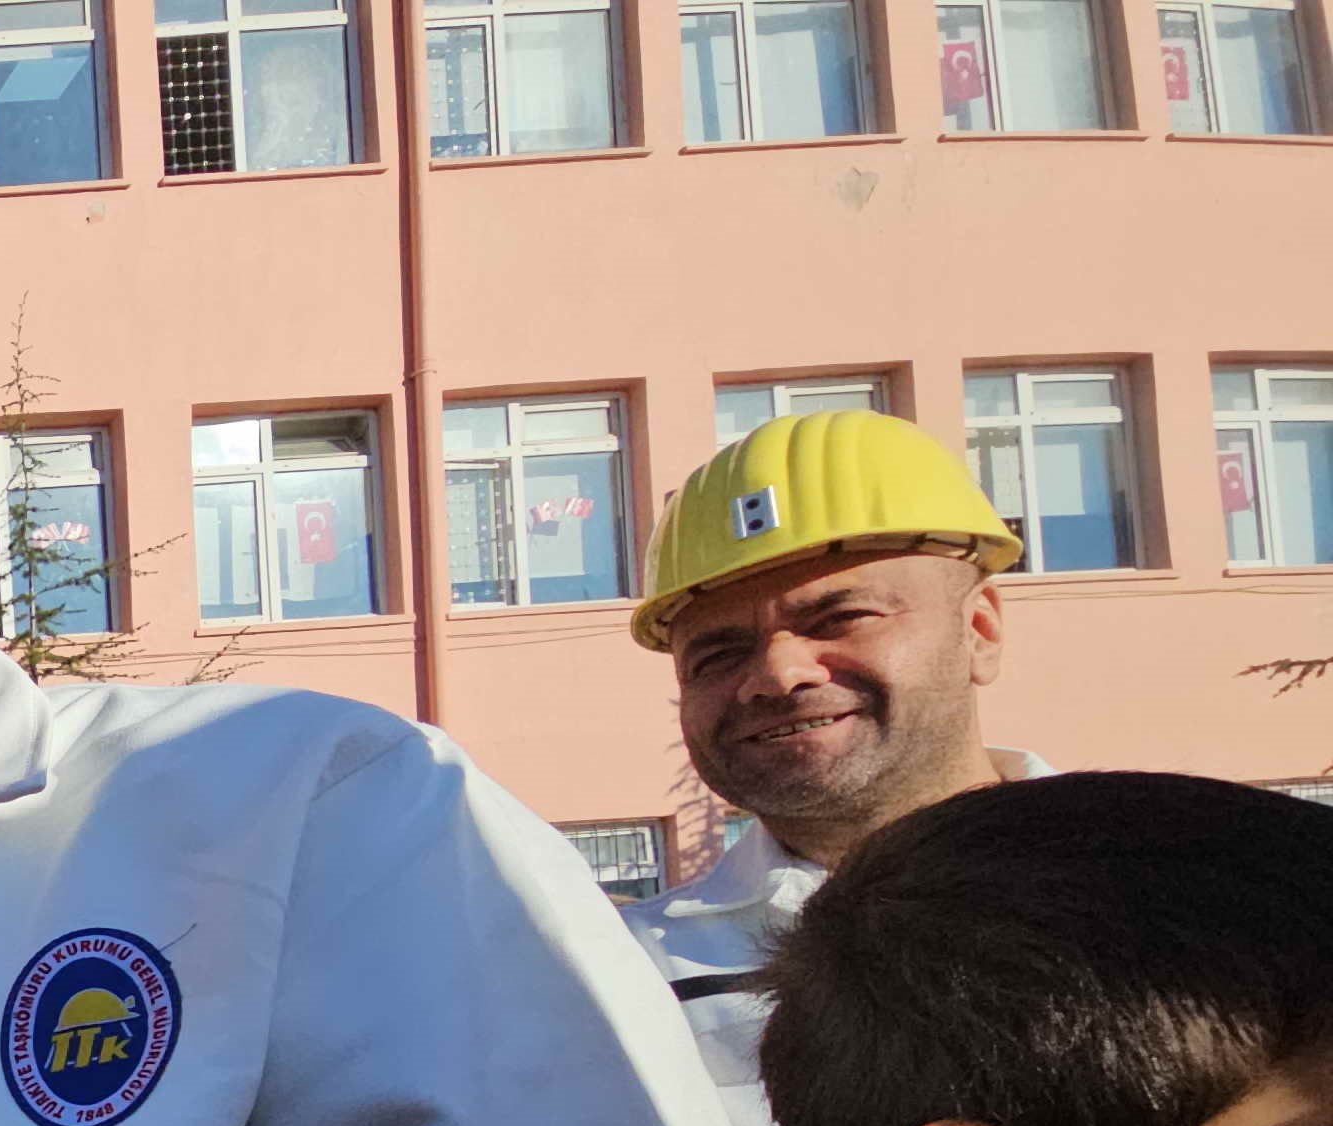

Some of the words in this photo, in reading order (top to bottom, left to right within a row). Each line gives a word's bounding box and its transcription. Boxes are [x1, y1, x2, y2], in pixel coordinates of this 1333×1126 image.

[52, 939, 132, 963] KURUMU
[129, 957, 165, 1005] GENEL
[76, 1102, 115, 1123] 1848
